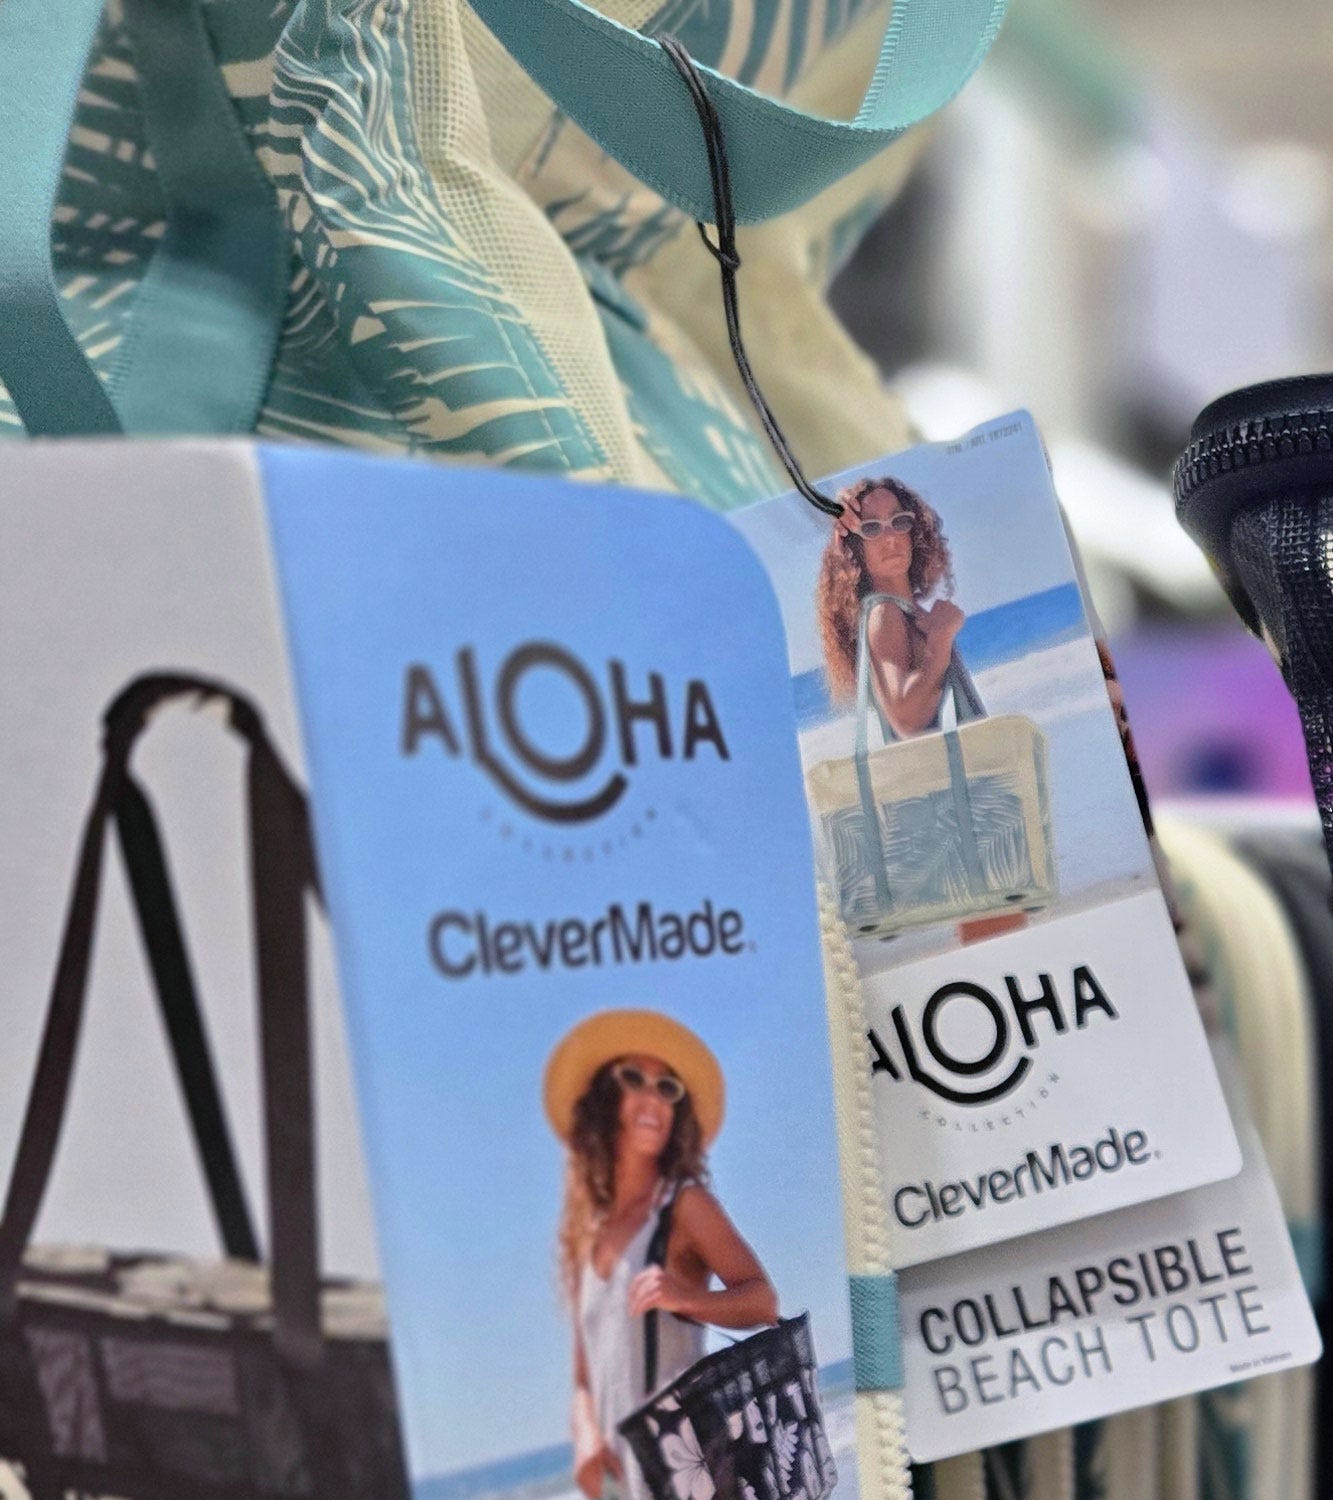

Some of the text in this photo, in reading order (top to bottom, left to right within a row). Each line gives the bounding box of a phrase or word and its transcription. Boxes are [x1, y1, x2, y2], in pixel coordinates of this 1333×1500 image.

[400, 638, 730, 825] ALOHA
[427, 900, 744, 980] CleverMade
[893, 1127, 1152, 1229] CleverMade
[919, 1228, 1252, 1356] COLLAPSIBLE
[932, 1285, 1272, 1417] BEACH TOTE
